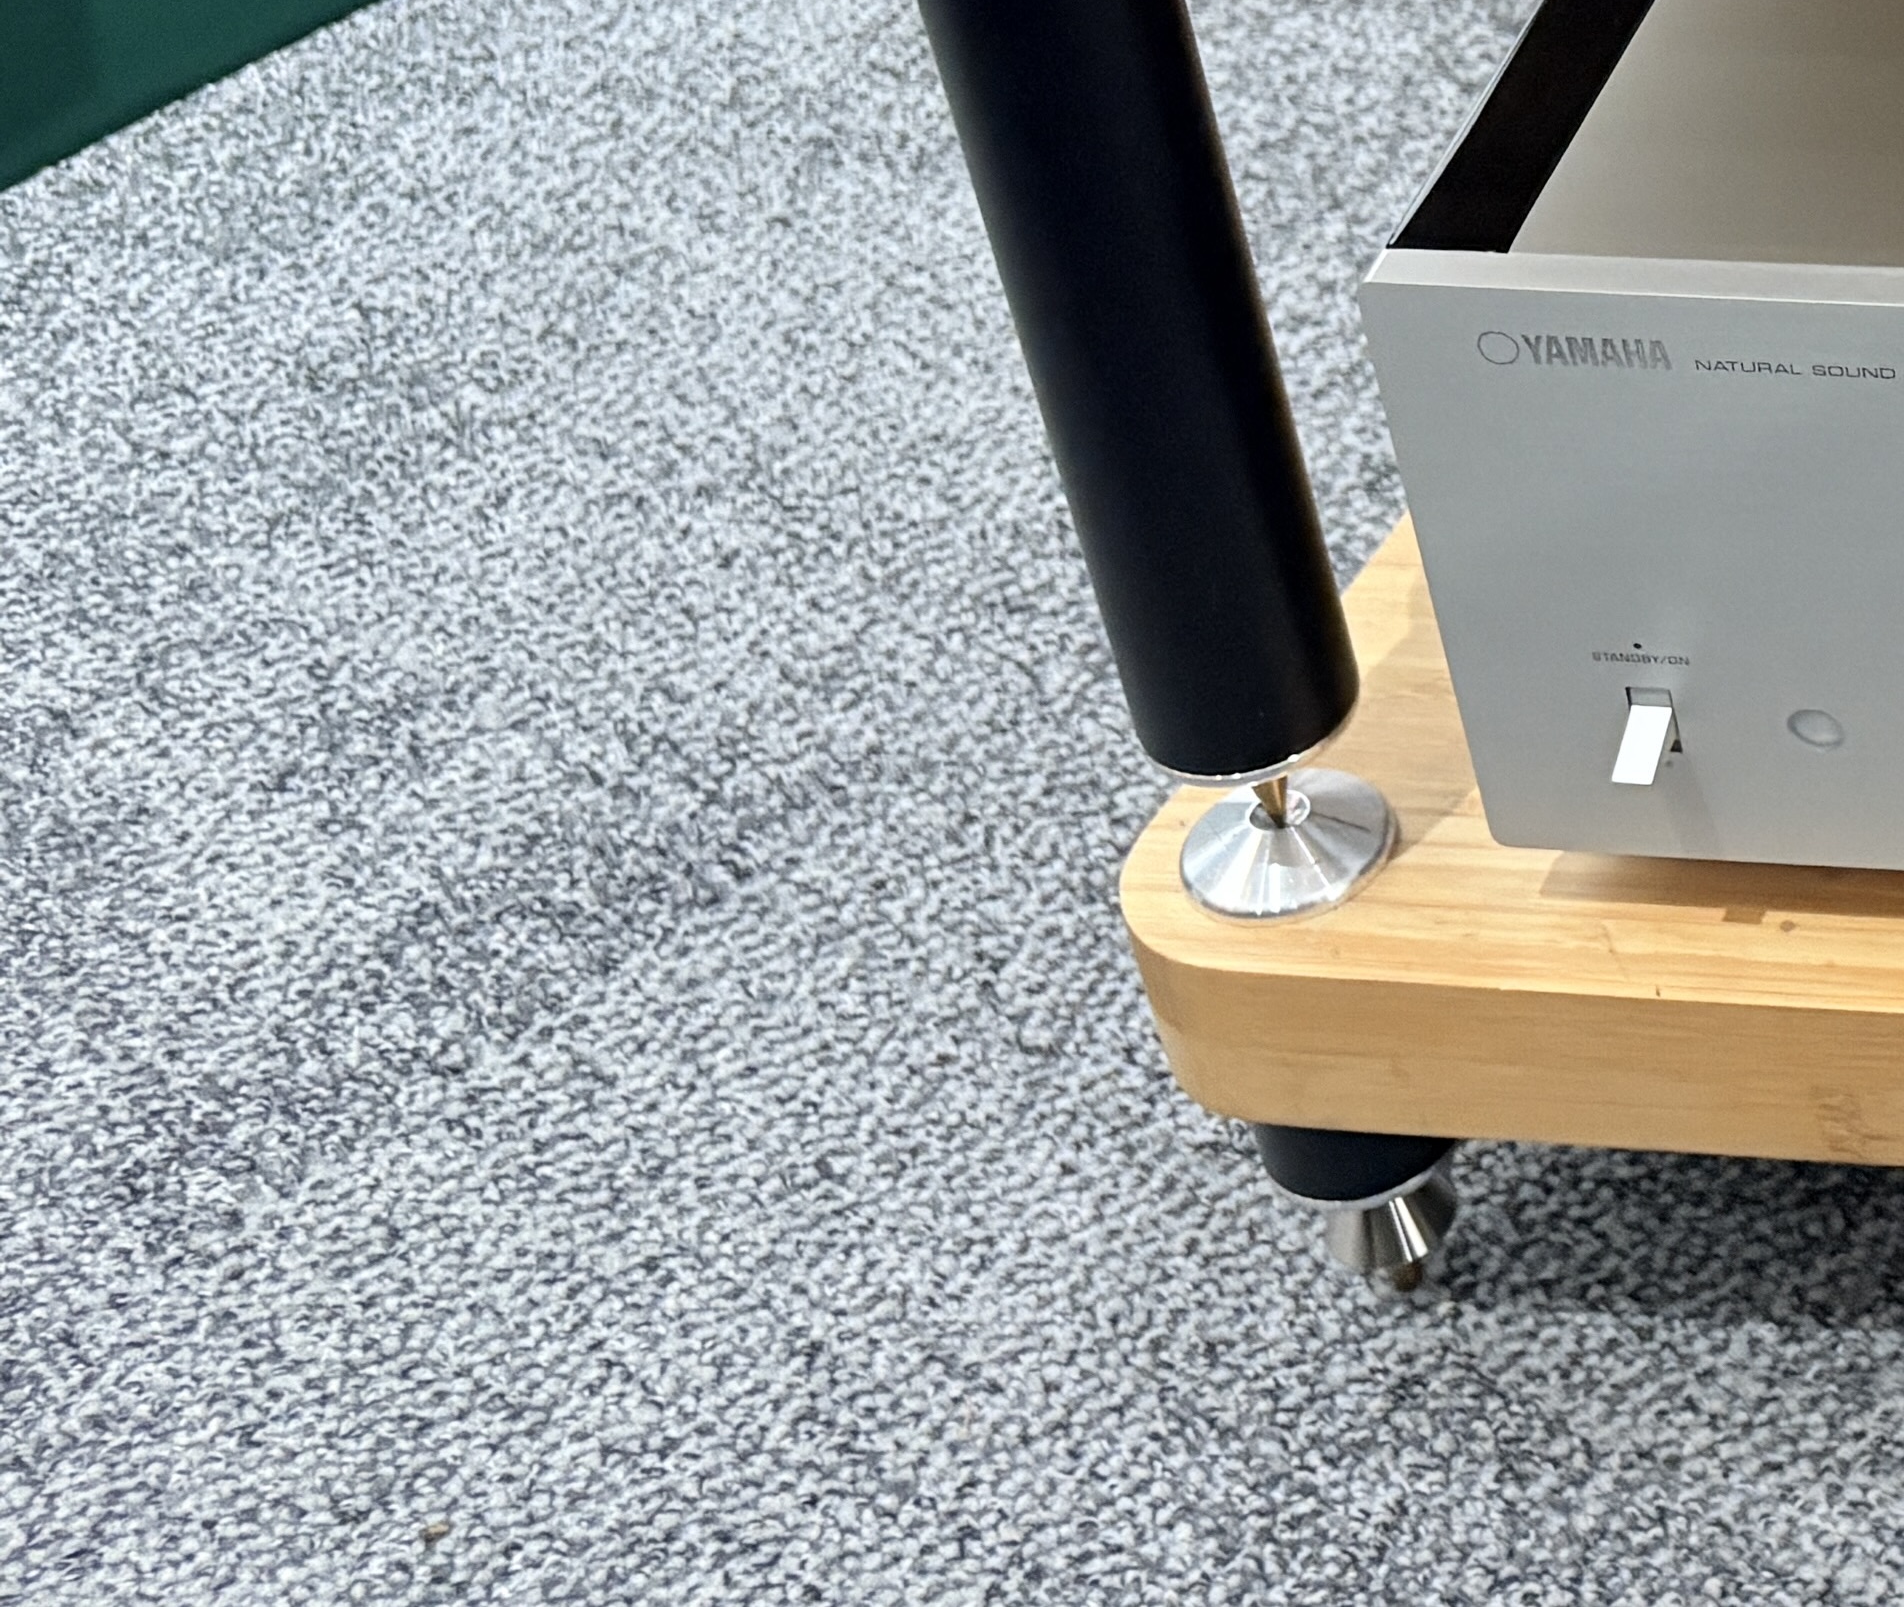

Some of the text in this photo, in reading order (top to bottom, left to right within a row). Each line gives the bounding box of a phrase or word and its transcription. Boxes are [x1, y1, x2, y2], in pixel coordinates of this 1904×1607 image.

[1521, 334, 1673, 371] YAMAHA
[1695, 360, 1802, 376] NATURAL
[1812, 365, 1896, 380] SOUND
[1591, 651, 1690, 666] STANDBY/ON
